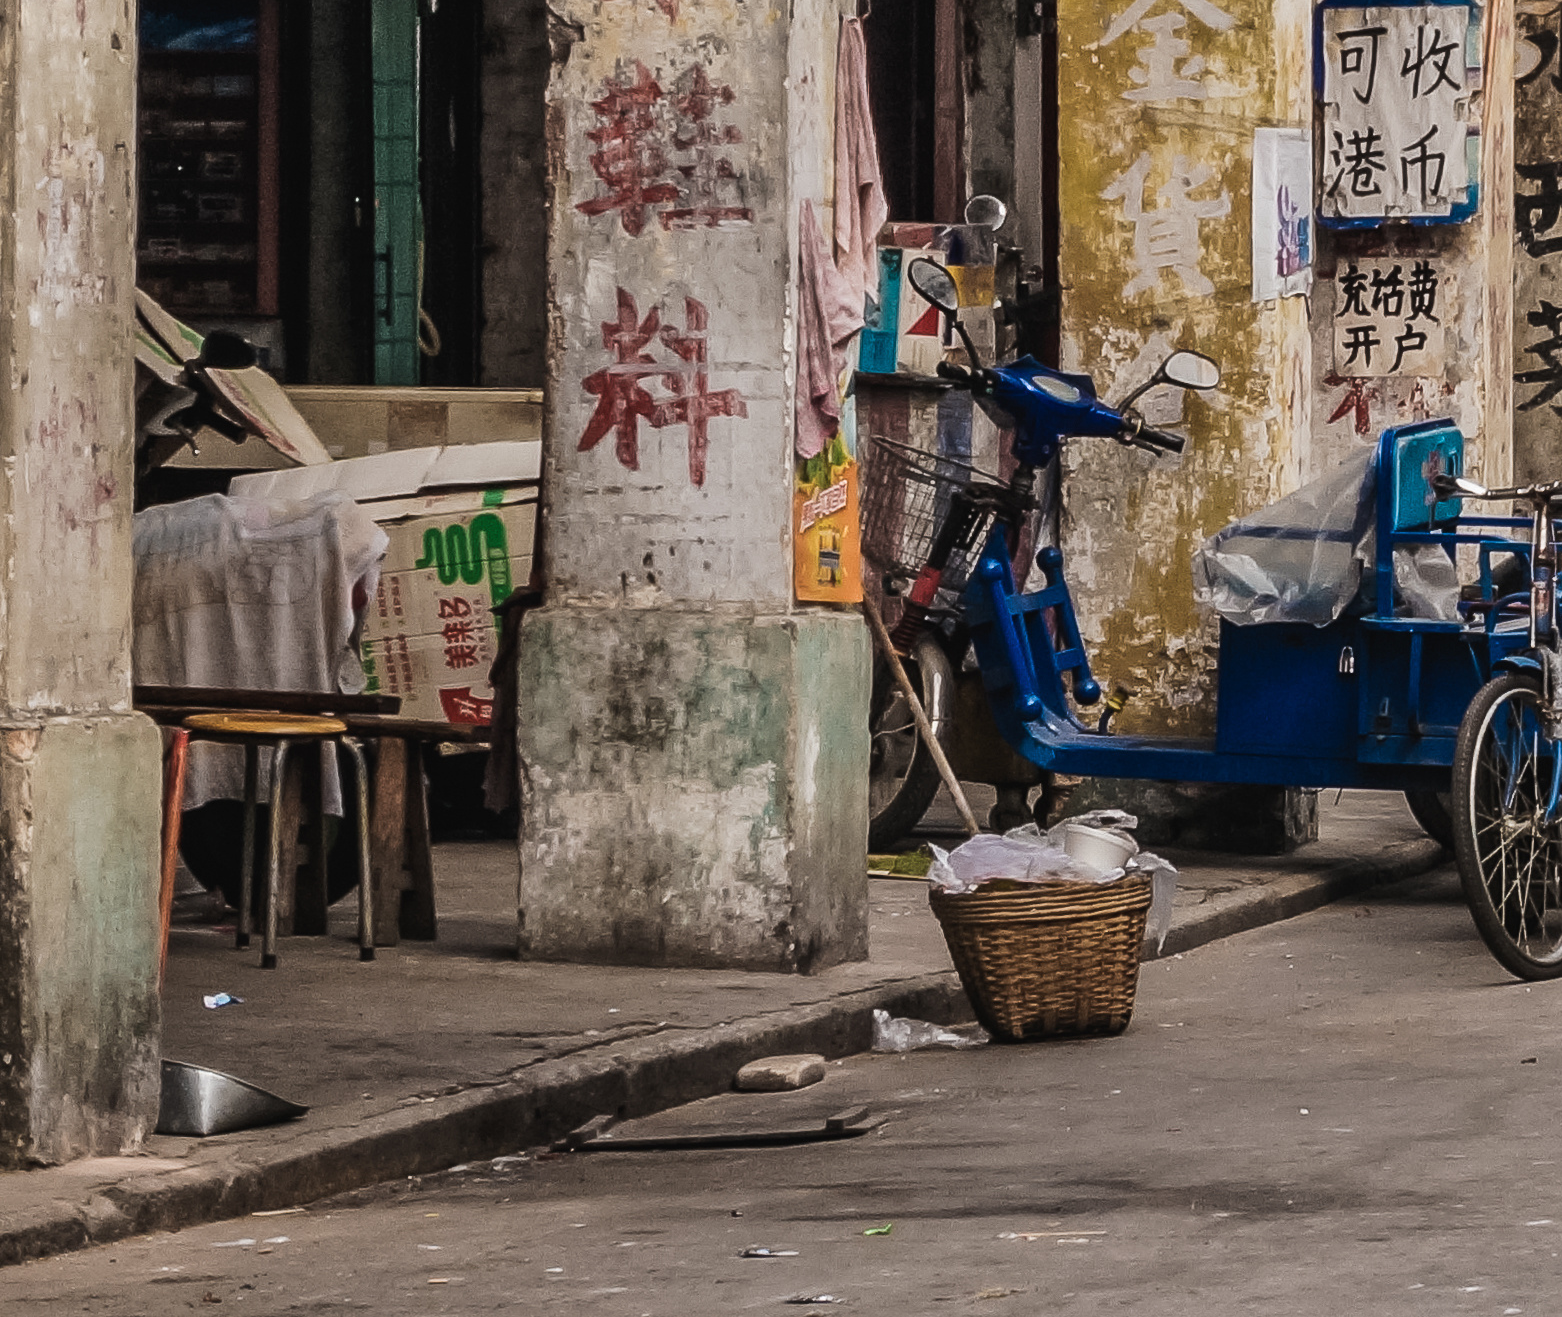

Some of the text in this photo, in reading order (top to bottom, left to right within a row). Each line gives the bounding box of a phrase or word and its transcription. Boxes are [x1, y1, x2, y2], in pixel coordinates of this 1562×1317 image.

[1335, 24, 1462, 105] 可收
[1326, 124, 1447, 199] 港币
[1342, 324, 1429, 374] 开户
